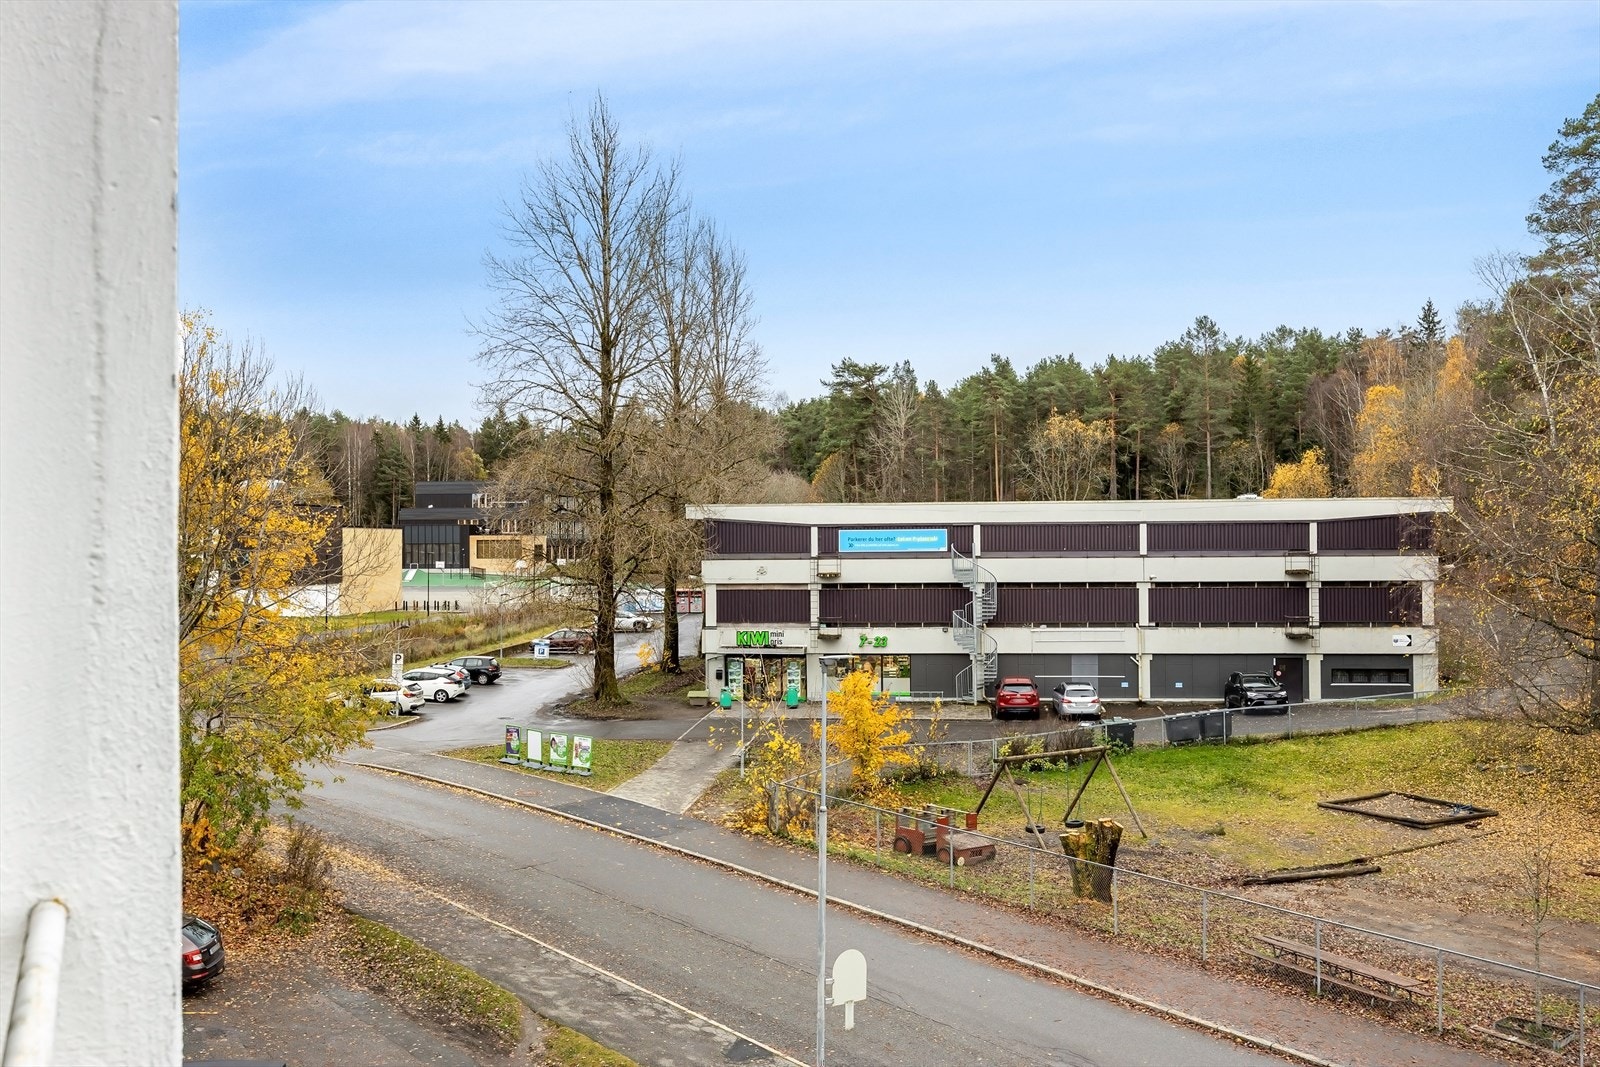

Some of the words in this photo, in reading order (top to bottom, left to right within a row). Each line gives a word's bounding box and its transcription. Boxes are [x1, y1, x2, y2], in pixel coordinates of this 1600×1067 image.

[736, 631, 769, 646] KIWI
[770, 637, 783, 646] pris
[394, 654, 402, 664] P
